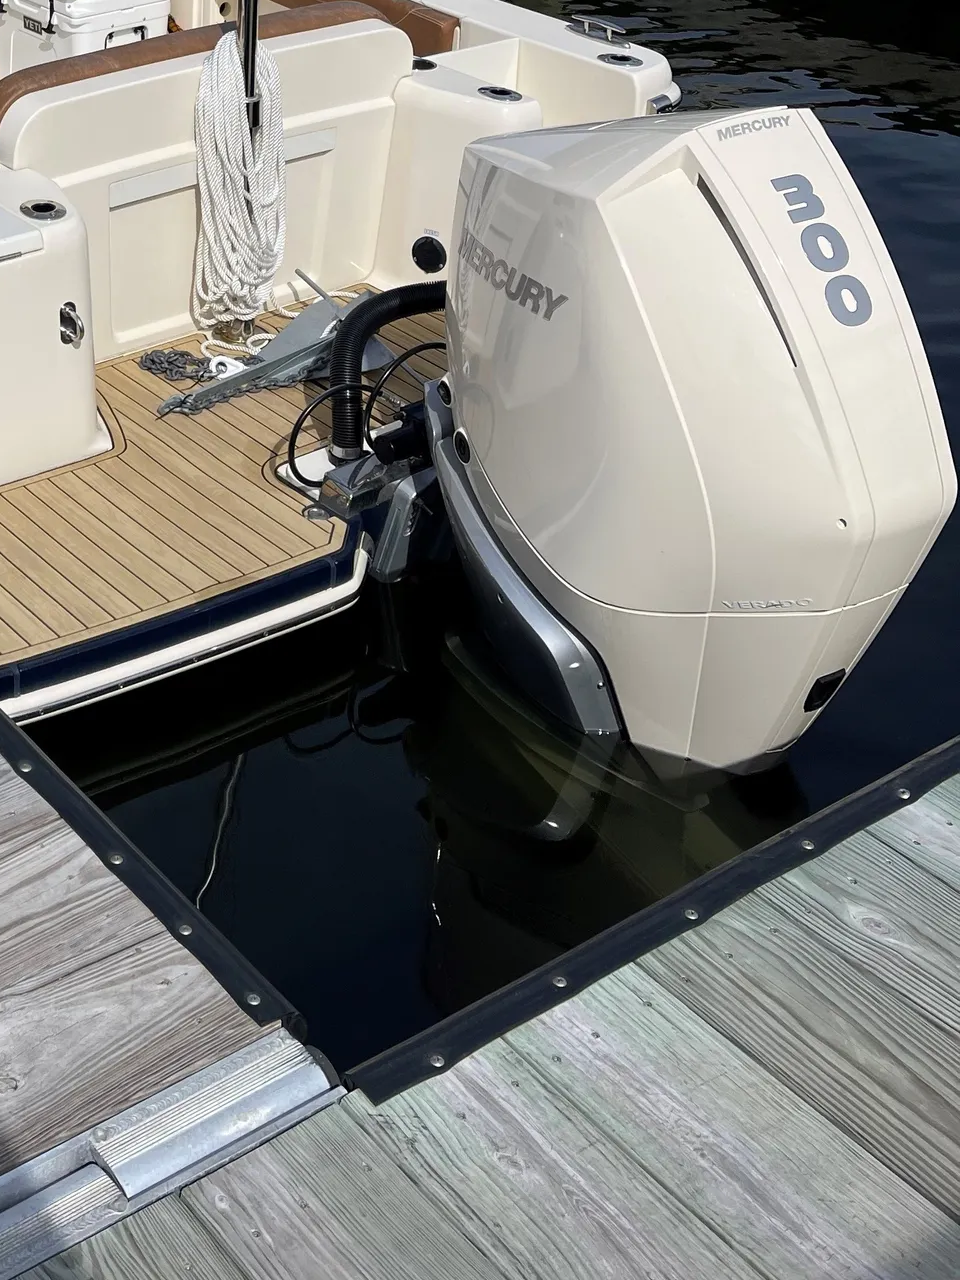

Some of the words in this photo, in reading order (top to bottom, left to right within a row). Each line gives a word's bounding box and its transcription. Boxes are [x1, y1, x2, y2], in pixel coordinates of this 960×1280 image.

[24, 17, 41, 33] YETI
[716, 115, 791, 142] MERCURY
[770, 173, 873, 327] 300
[458, 227, 569, 322] MERCURY
[720, 597, 814, 610] VERADO
